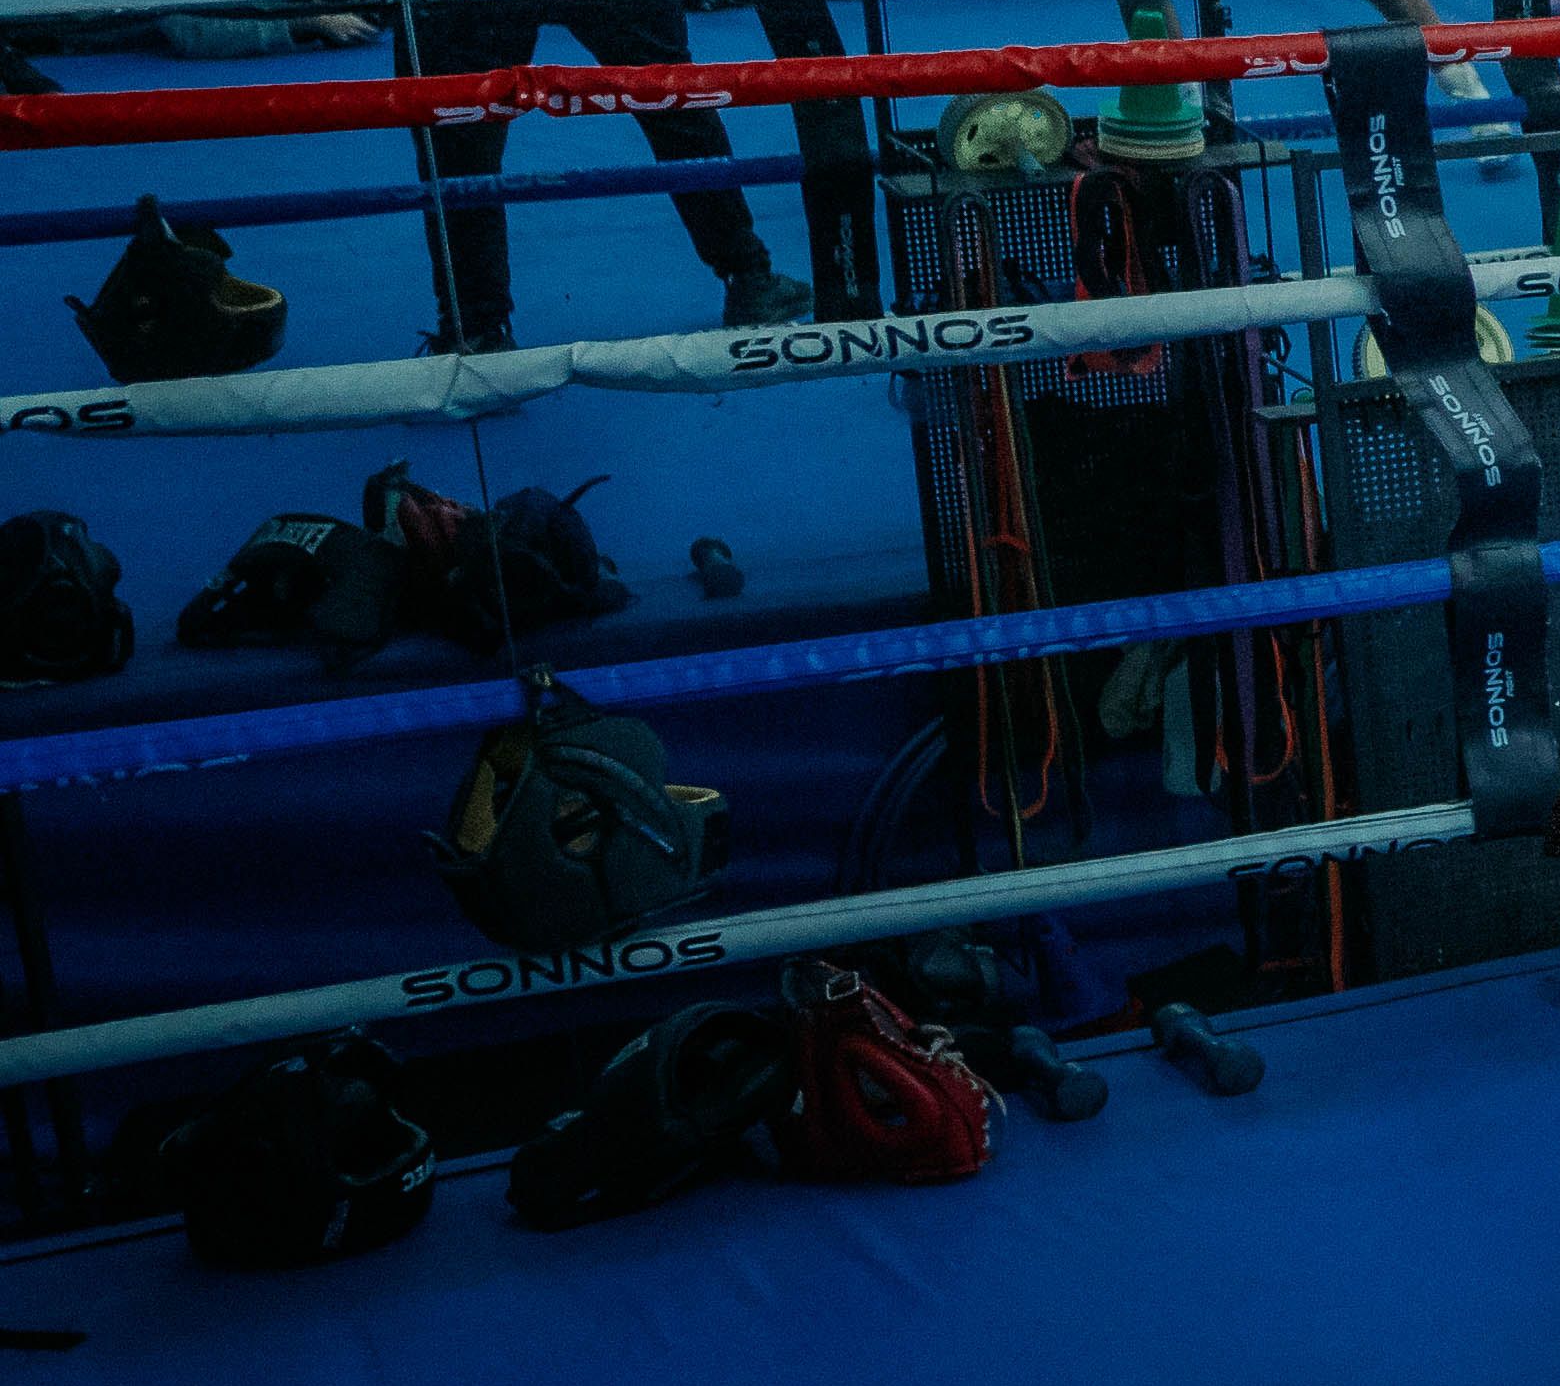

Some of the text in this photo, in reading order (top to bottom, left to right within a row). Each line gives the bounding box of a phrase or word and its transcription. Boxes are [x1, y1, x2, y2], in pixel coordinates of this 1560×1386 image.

[1368, 113, 1406, 239] SONNOS
[729, 314, 1034, 372] SONNOS
[1428, 375, 1501, 487] SONNOS
[1485, 632, 1509, 748] SONNOS
[401, 932, 726, 1007] SONNOS
